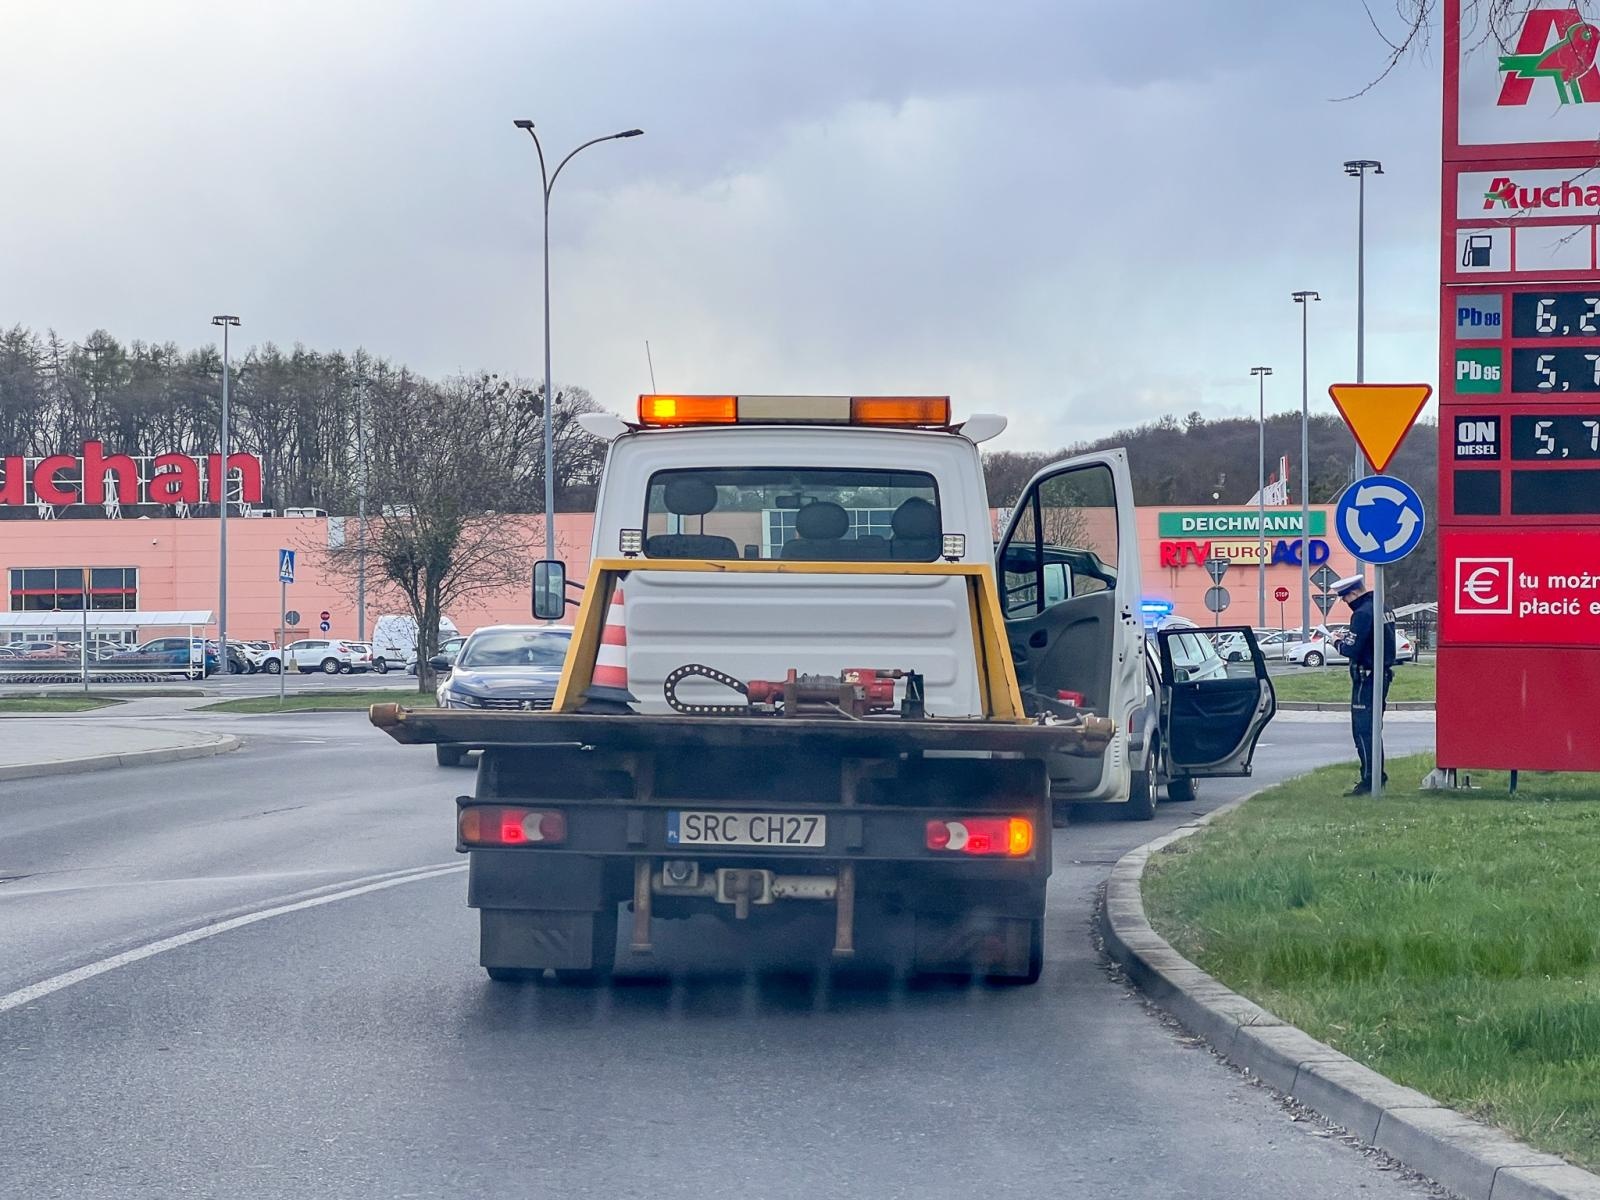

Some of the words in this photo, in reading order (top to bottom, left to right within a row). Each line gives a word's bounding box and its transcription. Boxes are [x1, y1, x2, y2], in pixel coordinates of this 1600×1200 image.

[1484, 177, 1600, 209] Aucha
[1458, 422, 1495, 442] ON
[1457, 445, 1496, 455] DIESEL
[1182, 517, 1303, 531] DEICHMANN
[1160, 541, 1211, 568] RTV
[1215, 547, 1268, 558] EURO
[1519, 572, 1538, 588] tu
[1519, 598, 1580, 618] płacić
[668, 830, 678, 839] PL
[686, 814, 738, 842] SRC
[749, 816, 819, 844] CH27
